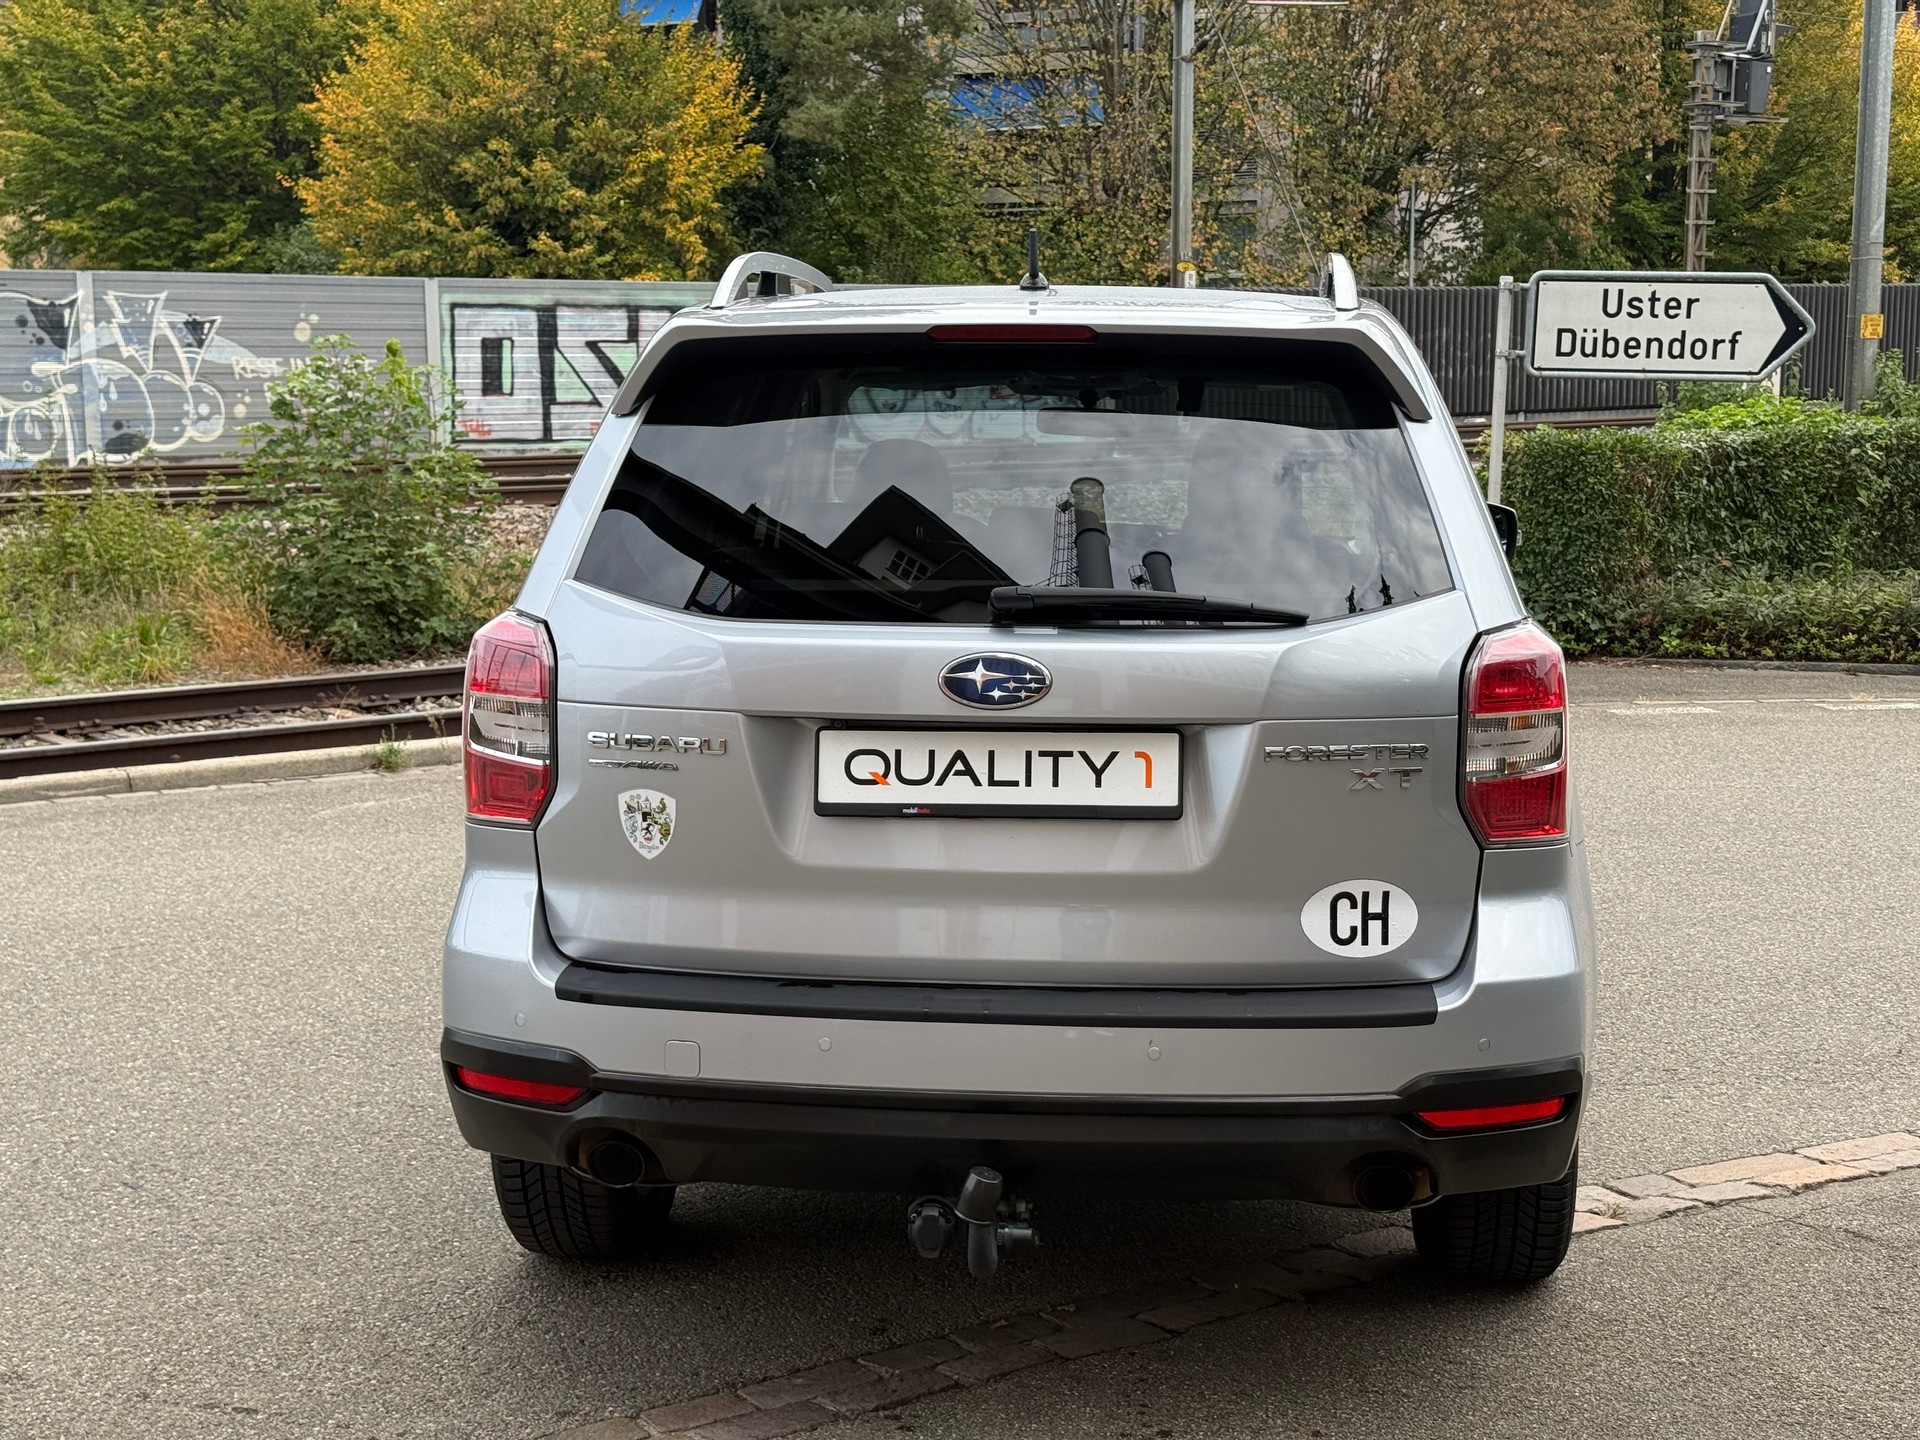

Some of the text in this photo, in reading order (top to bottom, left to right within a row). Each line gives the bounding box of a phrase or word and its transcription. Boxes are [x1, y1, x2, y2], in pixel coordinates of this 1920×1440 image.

[1601, 288, 1700, 319] Uster
[1555, 327, 1743, 360] Dübendorf
[231, 356, 283, 380] REST
[587, 731, 727, 755] SUBARU
[1264, 743, 1429, 762] FORESTER
[844, 748, 1153, 788] QUALITY 1
[1350, 767, 1423, 790] XT
[1329, 890, 1390, 946] CH
